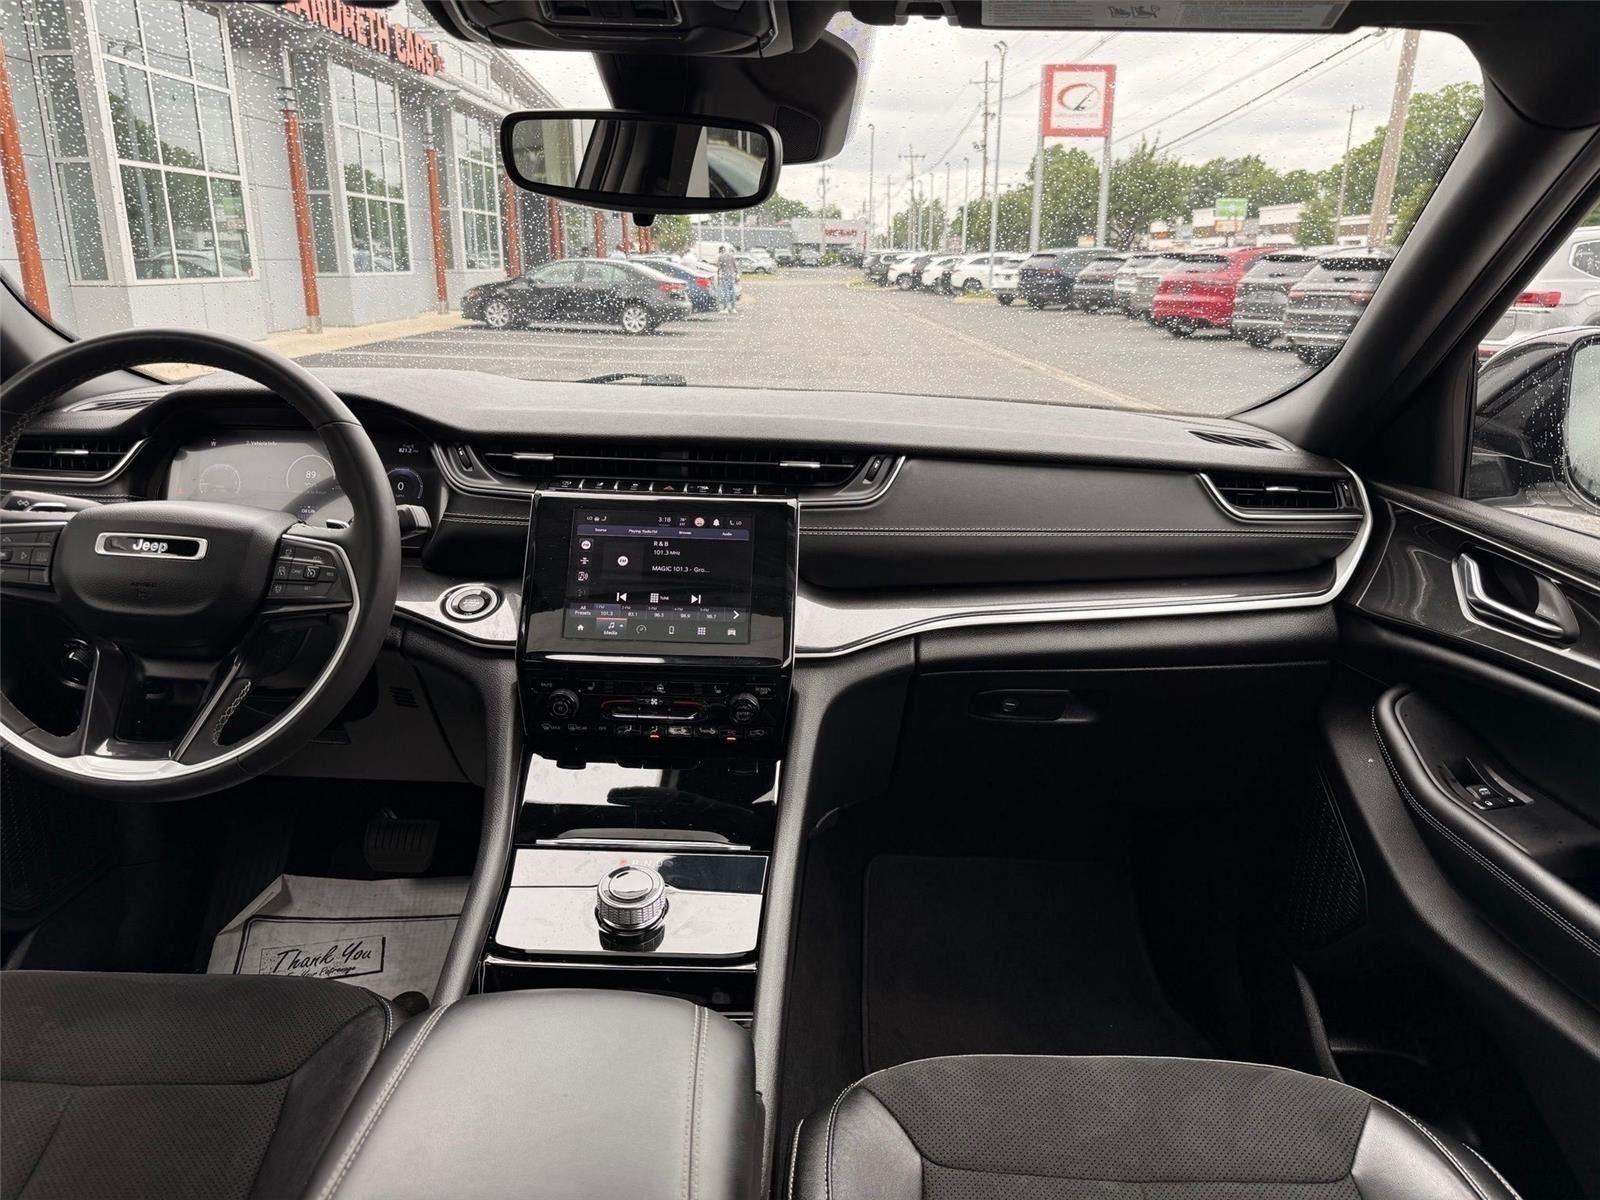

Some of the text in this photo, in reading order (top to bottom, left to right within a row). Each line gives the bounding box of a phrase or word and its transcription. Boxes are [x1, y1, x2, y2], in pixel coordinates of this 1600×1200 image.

[284, 0, 435, 77] ANDRETH CARS
[305, 470, 317, 479] 89
[397, 481, 405, 491] 0
[132, 538, 169, 553] Jeep
[272, 940, 372, 973] Thank You
